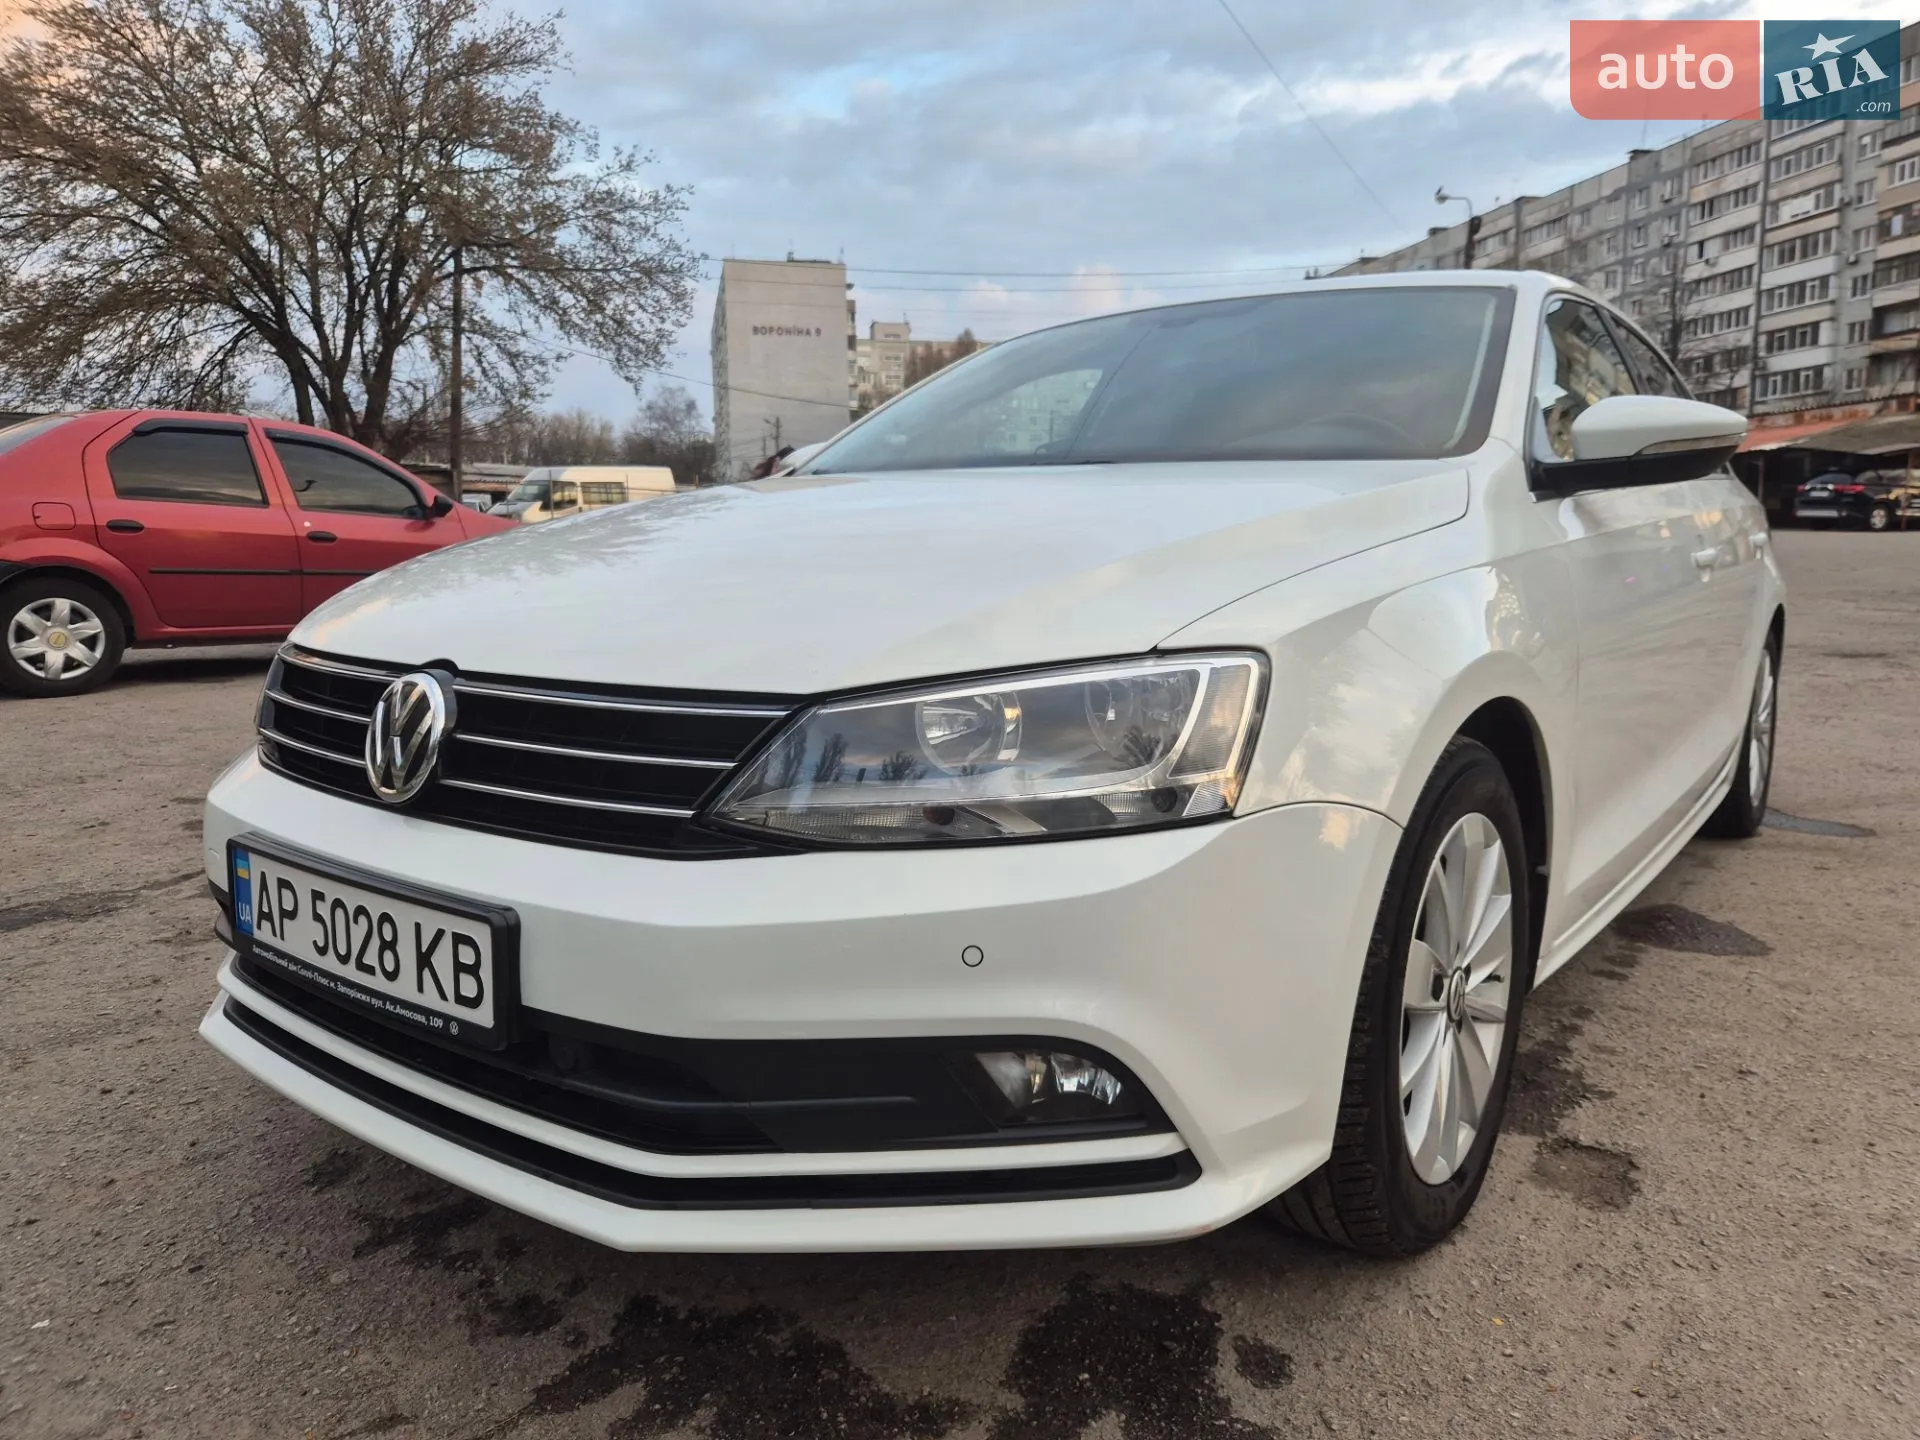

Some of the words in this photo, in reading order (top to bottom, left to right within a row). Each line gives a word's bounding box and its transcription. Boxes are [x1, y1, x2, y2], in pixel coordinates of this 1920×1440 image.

[238, 901, 252, 924] UA
[311, 888, 400, 982] 5028
[429, 1017, 443, 1029] 109
